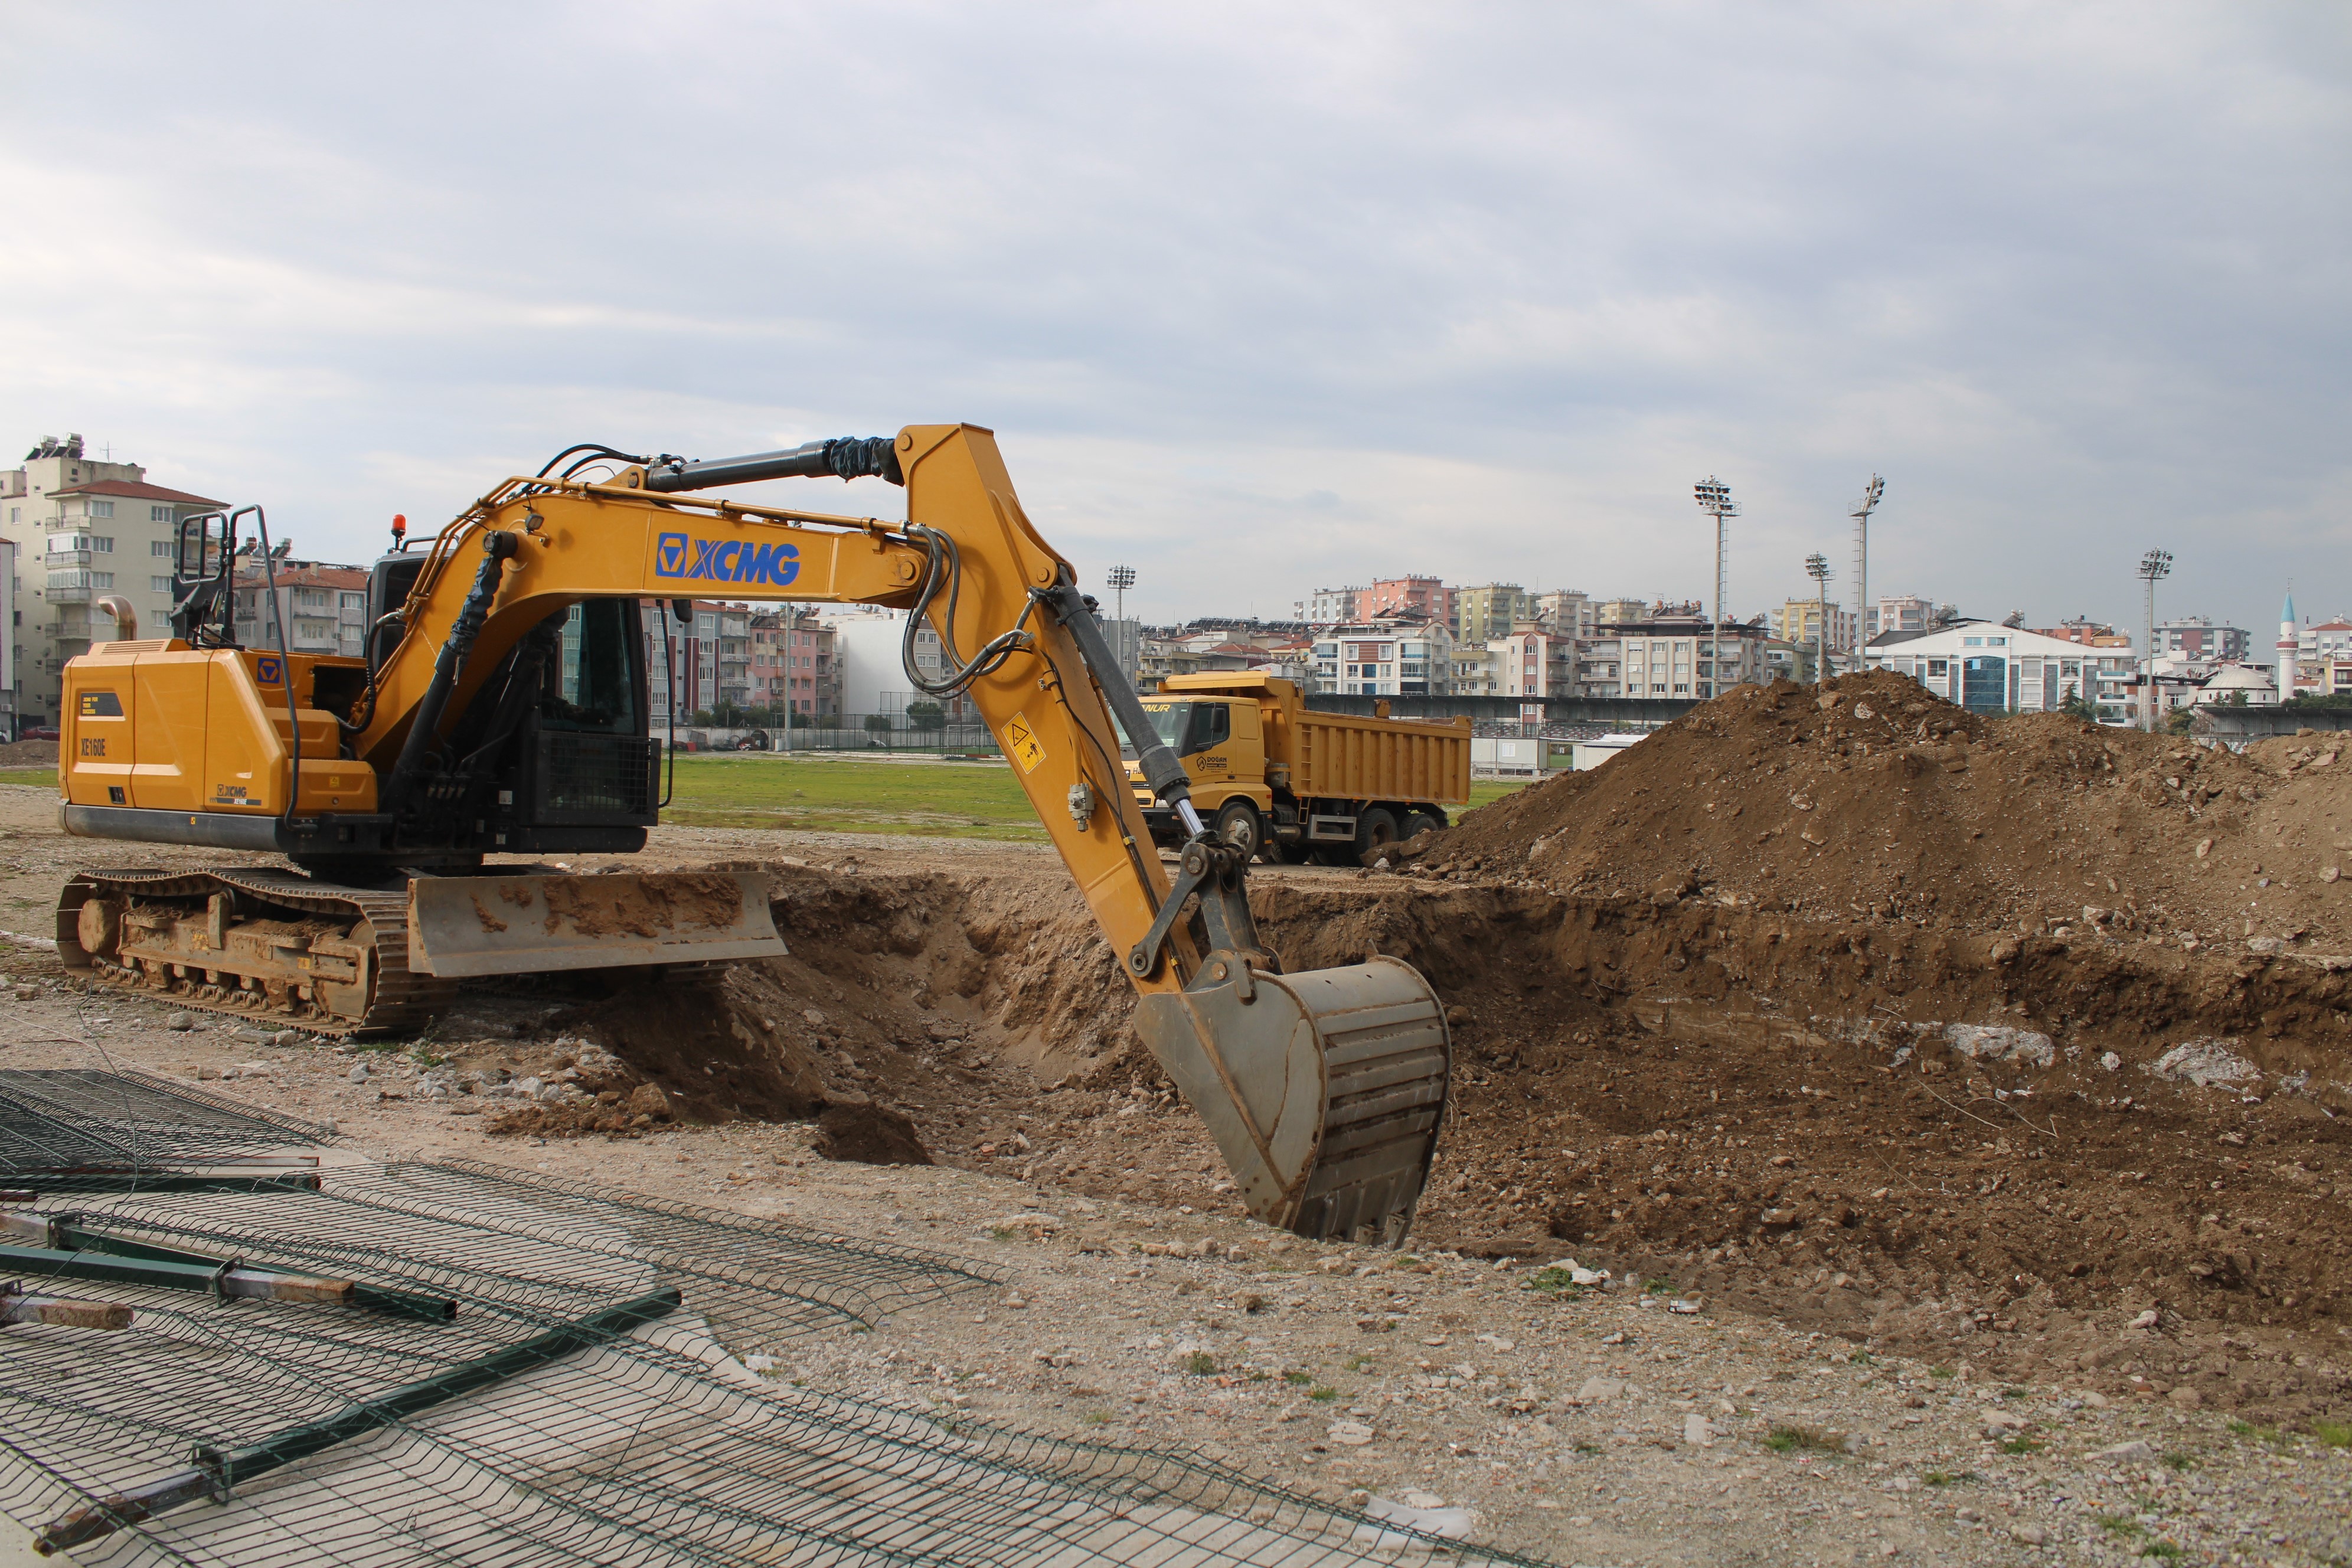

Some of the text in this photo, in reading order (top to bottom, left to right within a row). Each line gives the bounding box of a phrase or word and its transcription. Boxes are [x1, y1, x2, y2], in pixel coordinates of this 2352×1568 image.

[684, 538, 800, 586] XCMG
[81, 738, 106, 756] XE160E
[224, 786, 247, 798] XCMG
